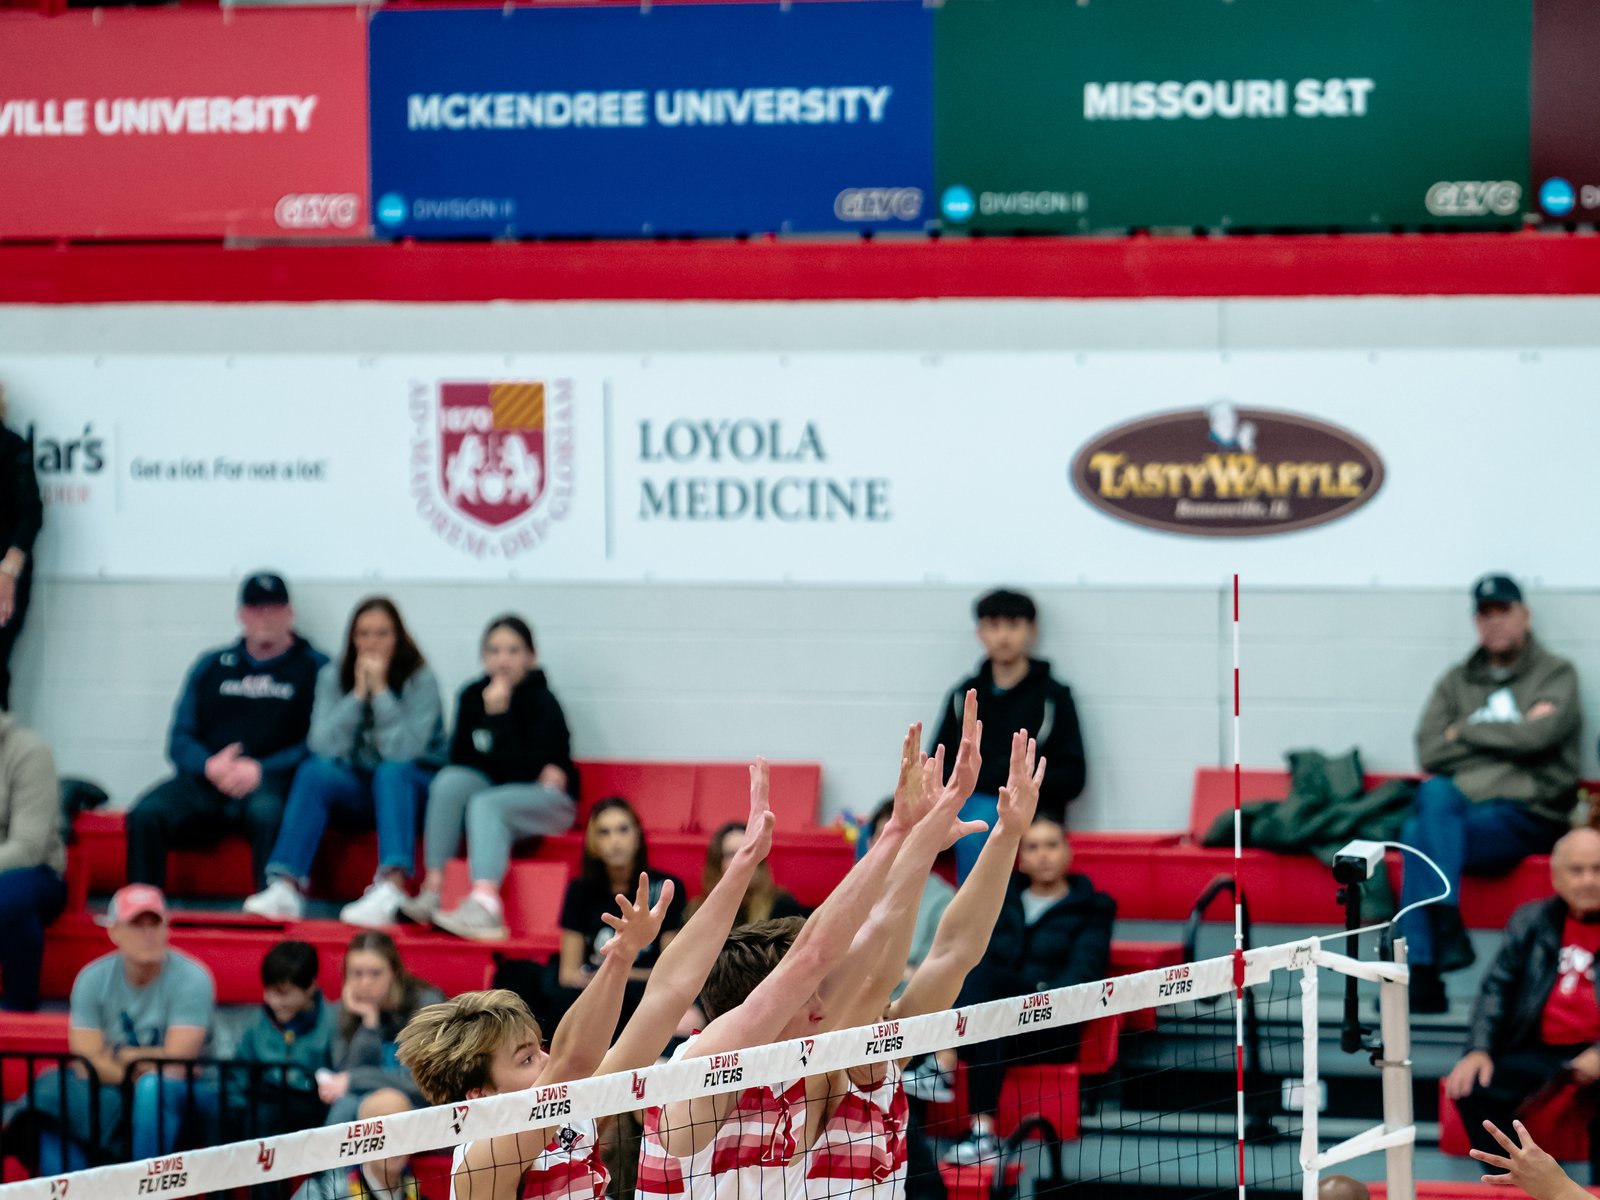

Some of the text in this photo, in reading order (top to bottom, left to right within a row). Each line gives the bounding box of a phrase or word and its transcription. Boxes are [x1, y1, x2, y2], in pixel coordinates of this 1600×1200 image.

[407, 85, 892, 131] MCKENDREE UNIVERSITY
[1083, 78, 1374, 120] MISSOURI S&T
[94, 94, 318, 135] UNIVERSITY
[637, 418, 826, 463] LOYOLA
[637, 478, 892, 522] MEDICINE
[1165, 966, 1190, 982] LEWIS
[1158, 979, 1193, 998] FLYERS
[1023, 993, 1050, 1010] LEWIS
[1018, 1006, 1052, 1026] FLYERS
[872, 1022, 900, 1039] LEWIS
[866, 1036, 904, 1055] FLYERS
[709, 1052, 739, 1070] LEWIS
[703, 1067, 743, 1087] FLYERS
[536, 1085, 568, 1103] LEWIS
[529, 1100, 571, 1121] FLYERS
[347, 1120, 383, 1139] LEWIS
[339, 1136, 386, 1158] FLYERS
[147, 1157, 183, 1175] LEWIS
[138, 1172, 188, 1195] FLYERS
